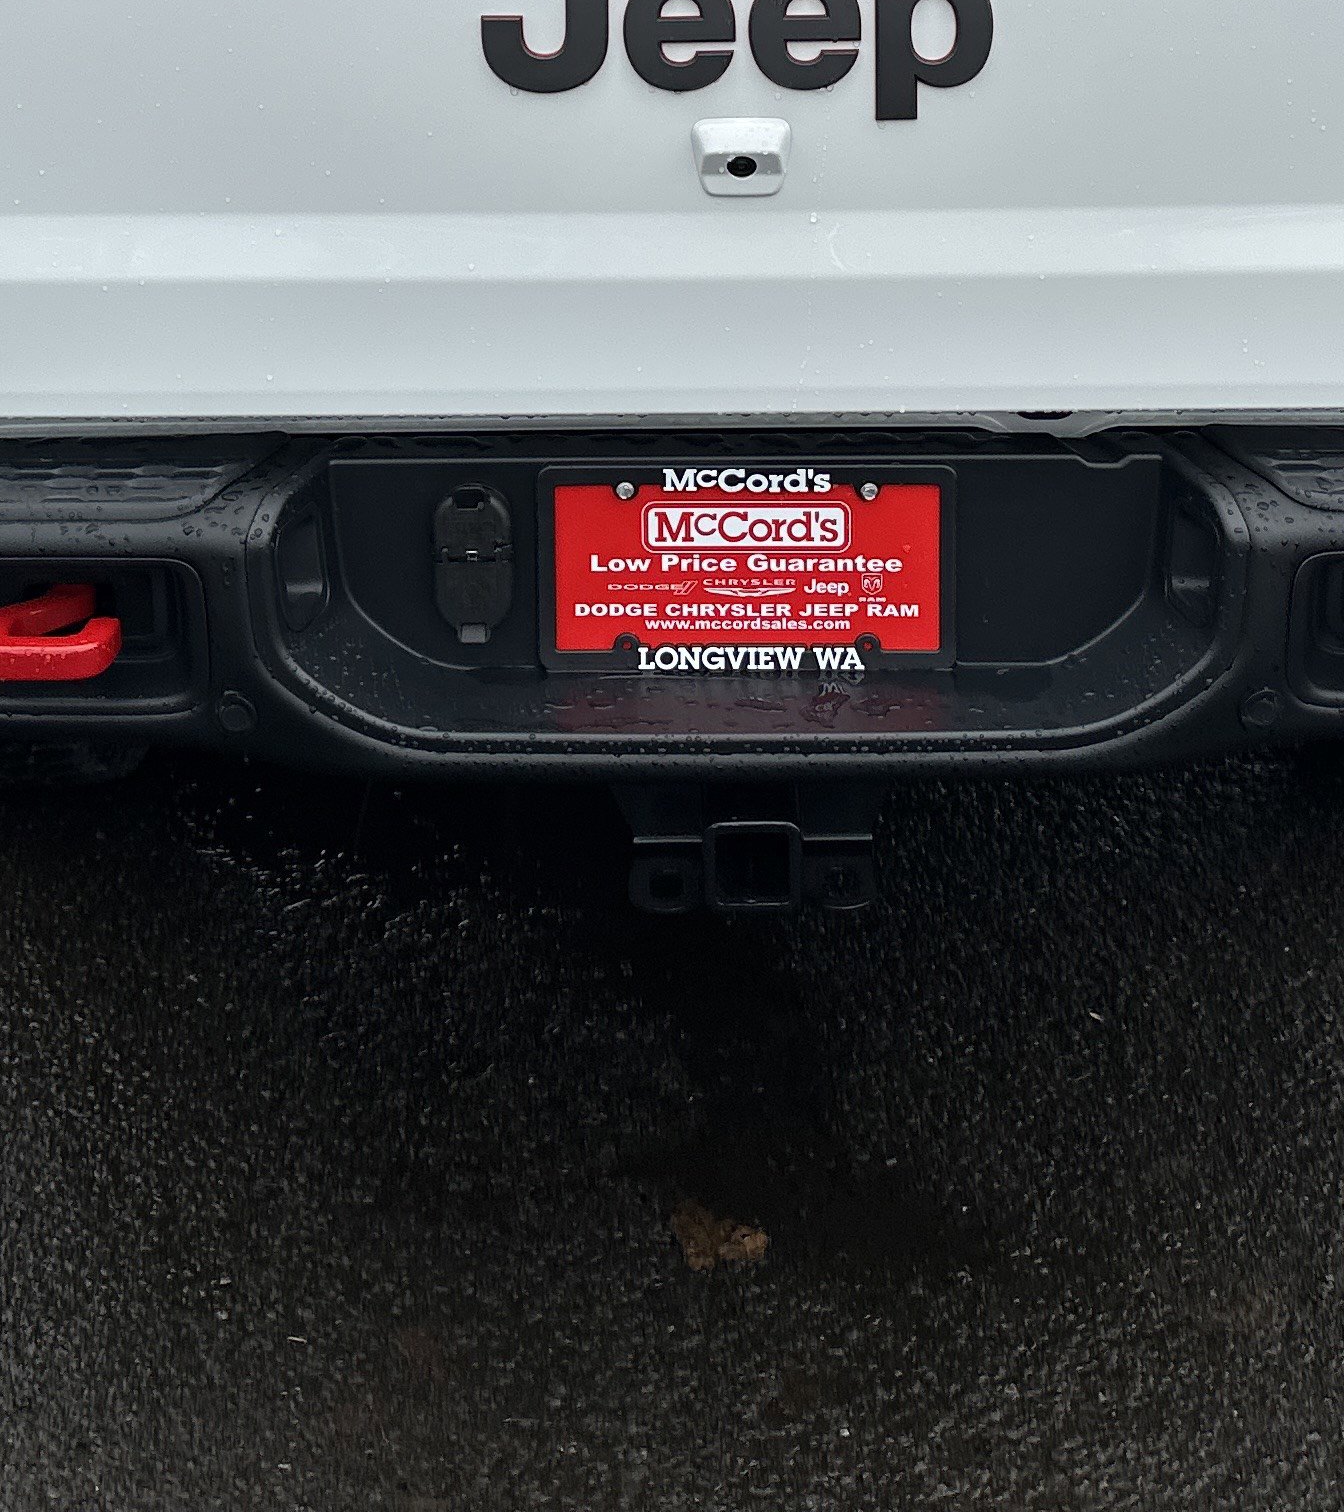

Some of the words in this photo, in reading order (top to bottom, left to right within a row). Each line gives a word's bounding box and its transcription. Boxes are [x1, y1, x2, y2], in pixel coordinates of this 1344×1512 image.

[663, 468, 831, 492] McCord's
[654, 511, 839, 542] McCord's
[590, 554, 651, 573] Low
[661, 554, 738, 573] Price
[747, 554, 903, 573] Guarantee
[607, 583, 685, 591] DODGE
[703, 578, 797, 586] CHRYSLER
[803, 578, 850, 597] Jeep
[574, 603, 658, 617] DODGE
[665, 603, 792, 617] CHRYSLER
[799, 603, 859, 617] JEEP
[867, 604, 920, 617] RAM
[644, 617, 851, 630] www.mccordsales.com
[638, 646, 803, 670] LONGVIEW
[813, 646, 865, 670] WA
